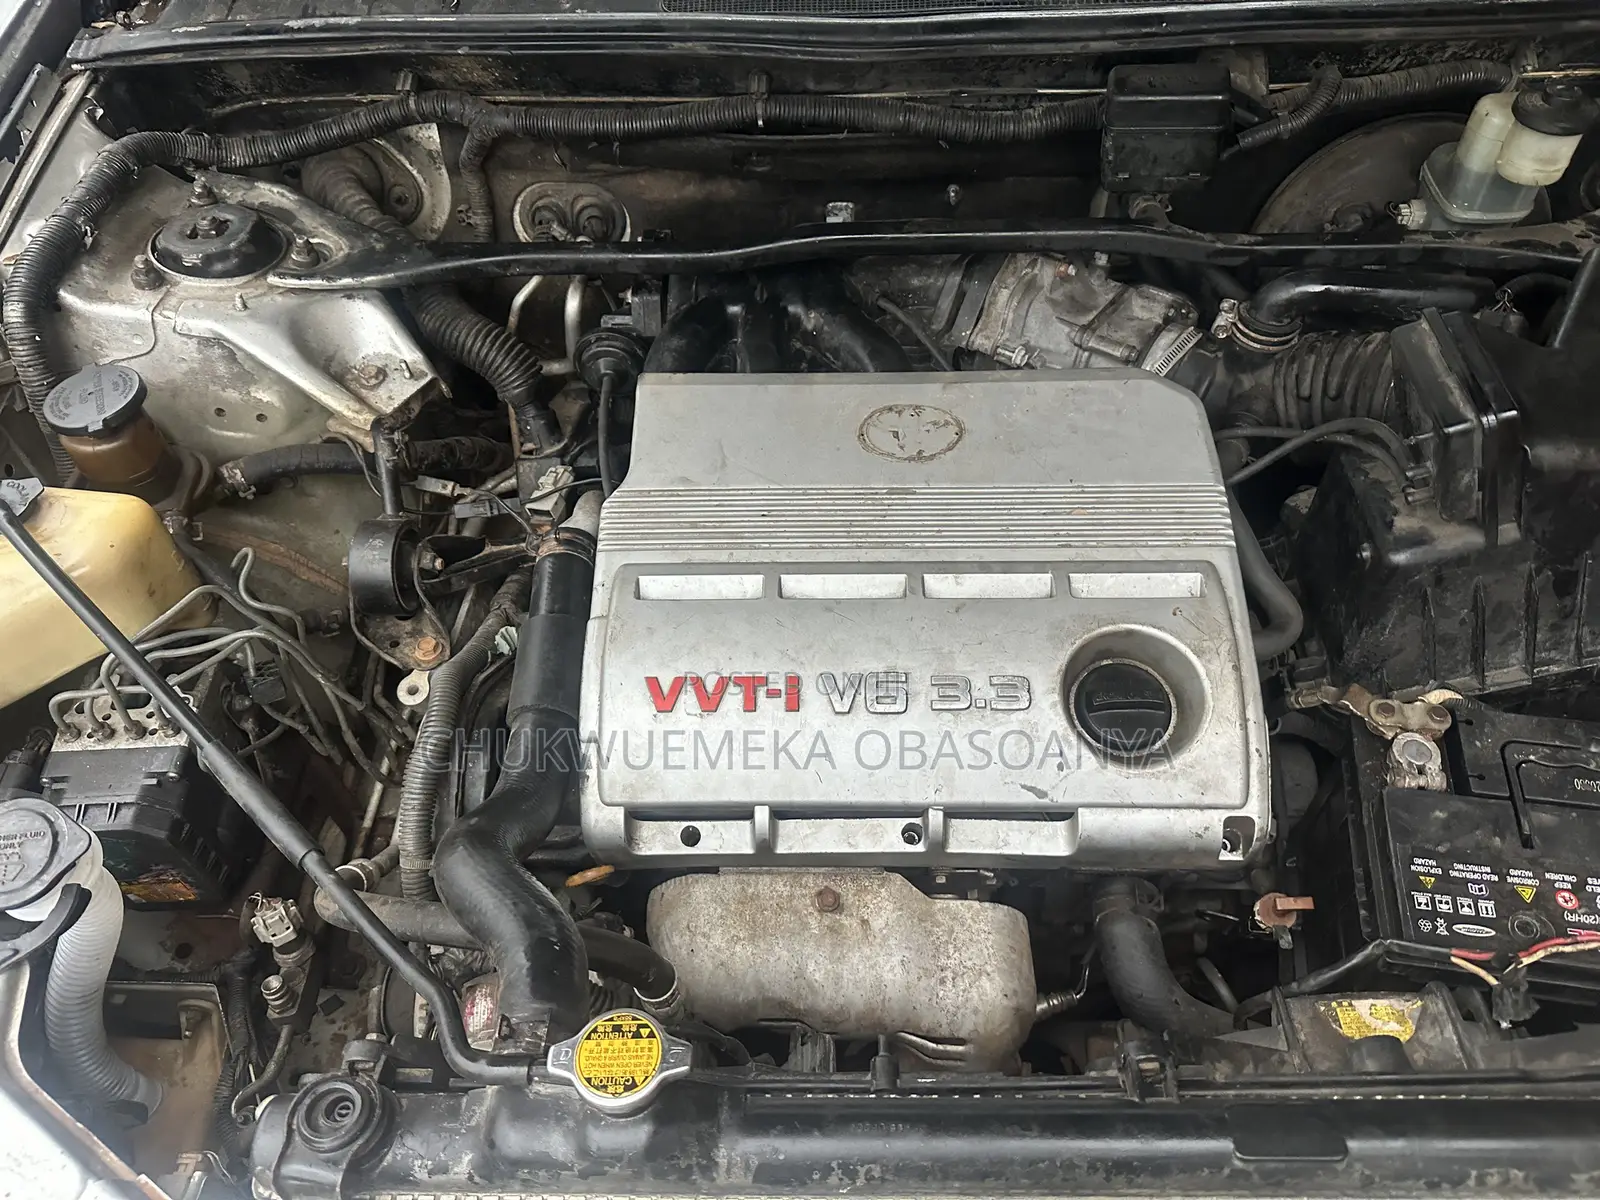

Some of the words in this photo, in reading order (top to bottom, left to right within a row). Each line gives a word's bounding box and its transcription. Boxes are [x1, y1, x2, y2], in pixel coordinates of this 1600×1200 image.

[644, 675, 800, 713] VVT-I
[821, 672, 909, 714] V6
[930, 675, 1031, 711] 3.3
[1413, 857, 1437, 866] HAZARD
[1410, 864, 1443, 875] EXPLOSION
[1453, 862, 1491, 873] INSTRUCTING
[1509, 868, 1533, 878] HAZARD
[1448, 869, 1481, 880] OPERATING
[1481, 873, 1499, 882] READ
[1544, 871, 1577, 883] CHILDREN
[1505, 875, 1539, 887] CORROSIVE
[1554, 881, 1572, 890] KEEP
[1564, 911, 1600, 924] (20HR)
[591, 1077, 632, 1085] CAUTION
